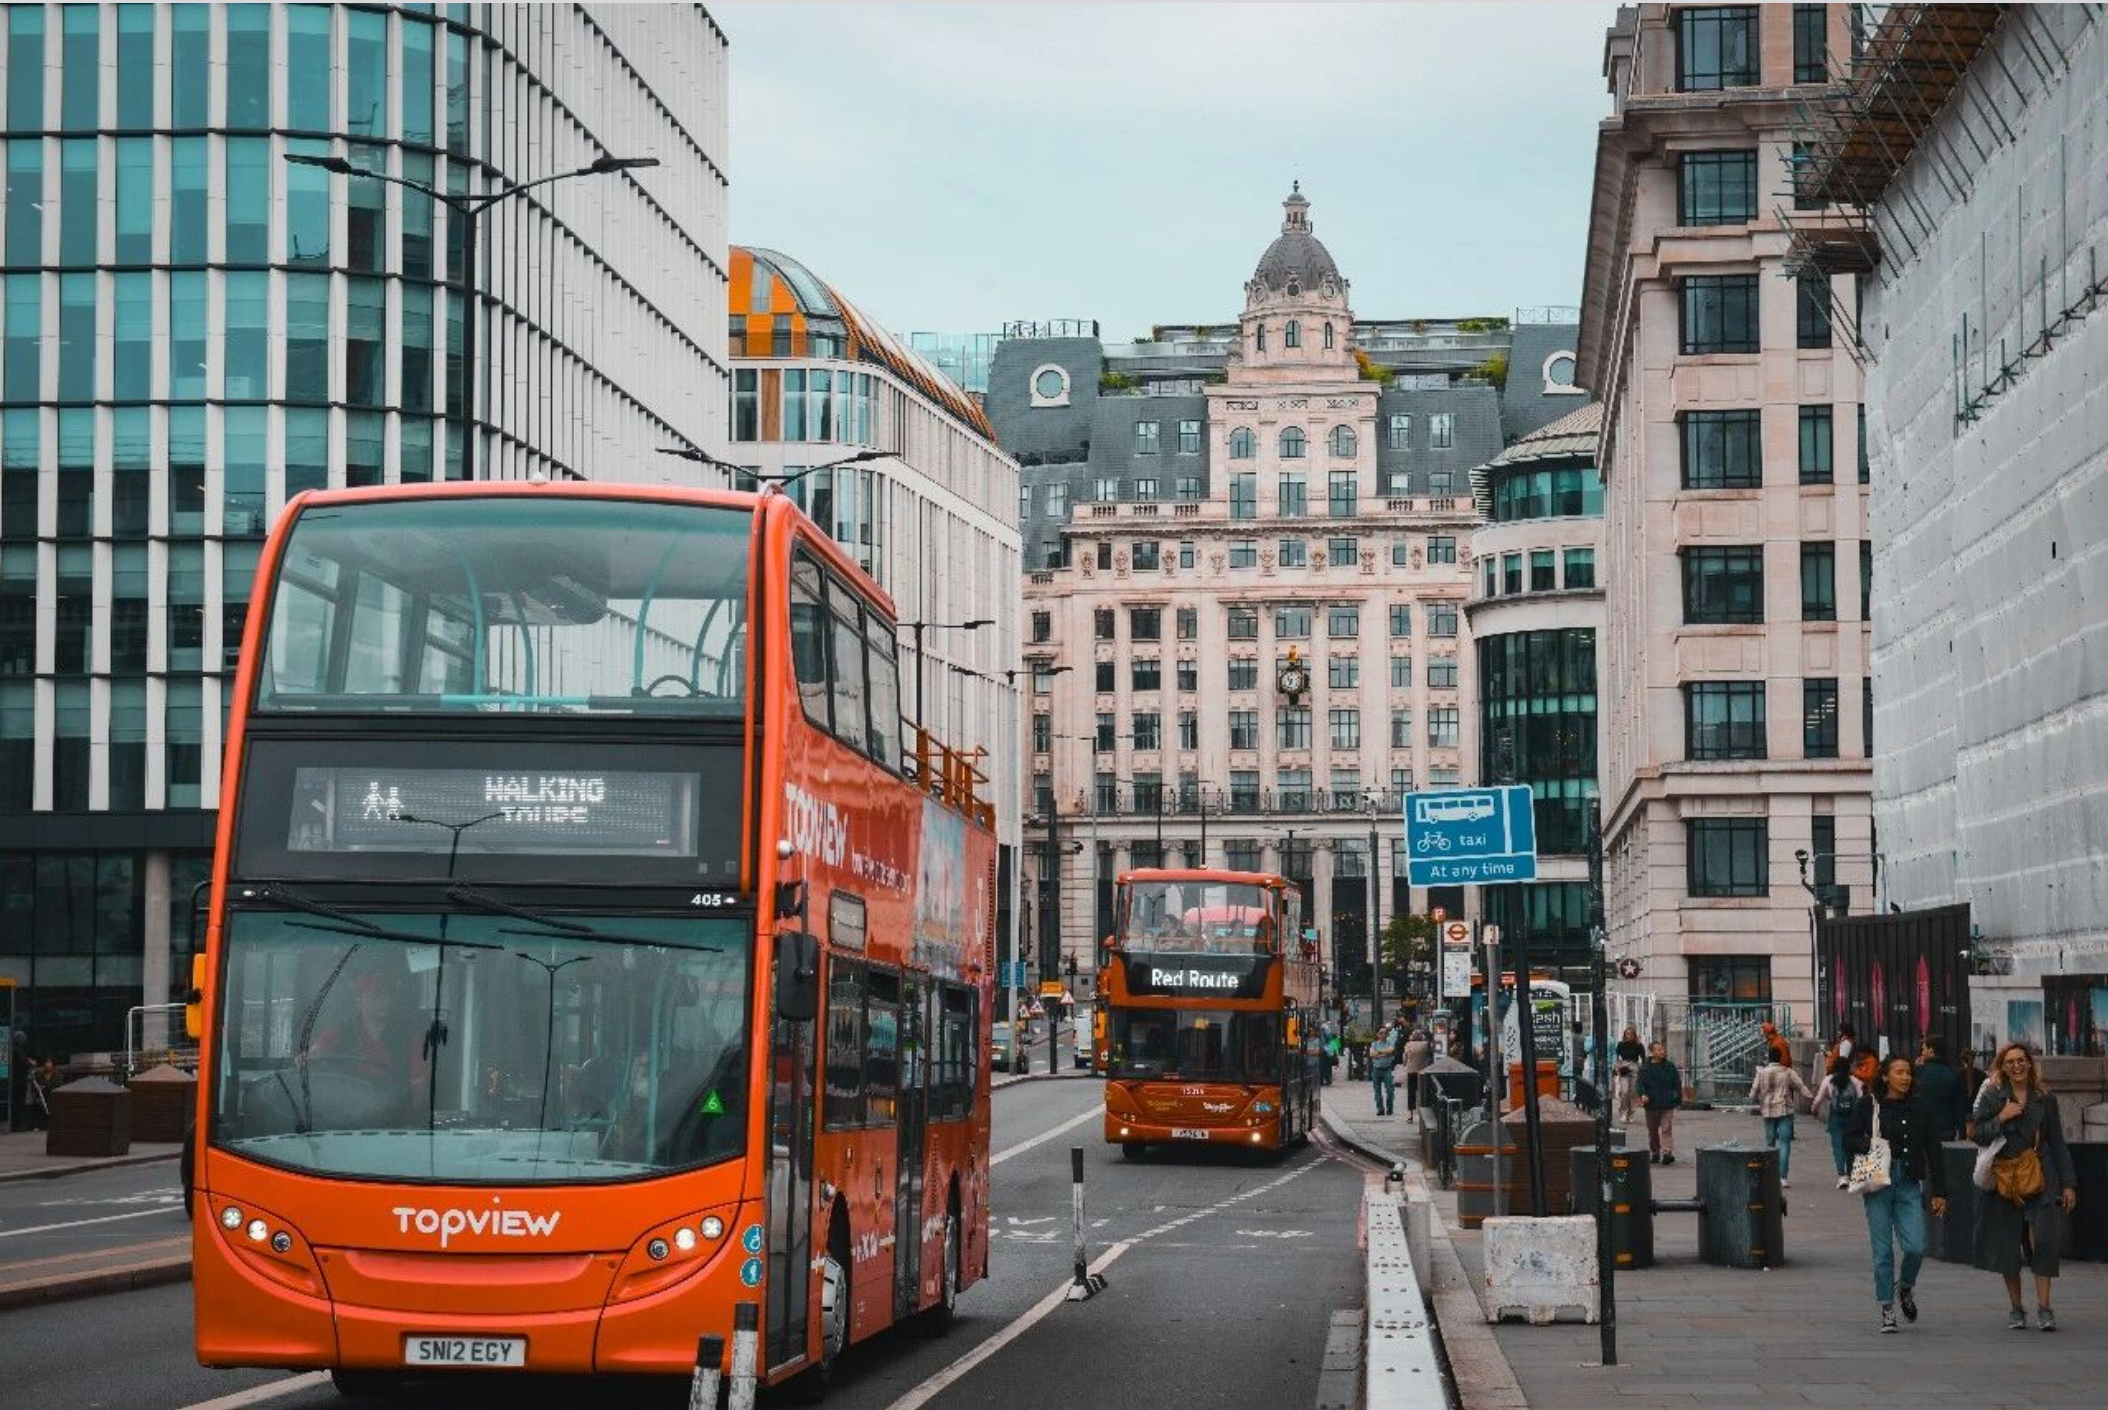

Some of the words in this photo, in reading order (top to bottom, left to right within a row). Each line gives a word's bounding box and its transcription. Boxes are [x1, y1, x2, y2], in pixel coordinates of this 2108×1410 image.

[485, 776, 605, 802] WALKING
[1460, 832, 1487, 847] taxi
[1430, 865, 1448, 878] At
[1451, 866, 1478, 879] any
[1482, 861, 1515, 876] time
[691, 893, 722, 907] 405
[1151, 968, 1184, 986] Red
[1189, 969, 1239, 988] Route
[419, 1340, 466, 1360] SN12
[470, 1342, 512, 1362] EGY
